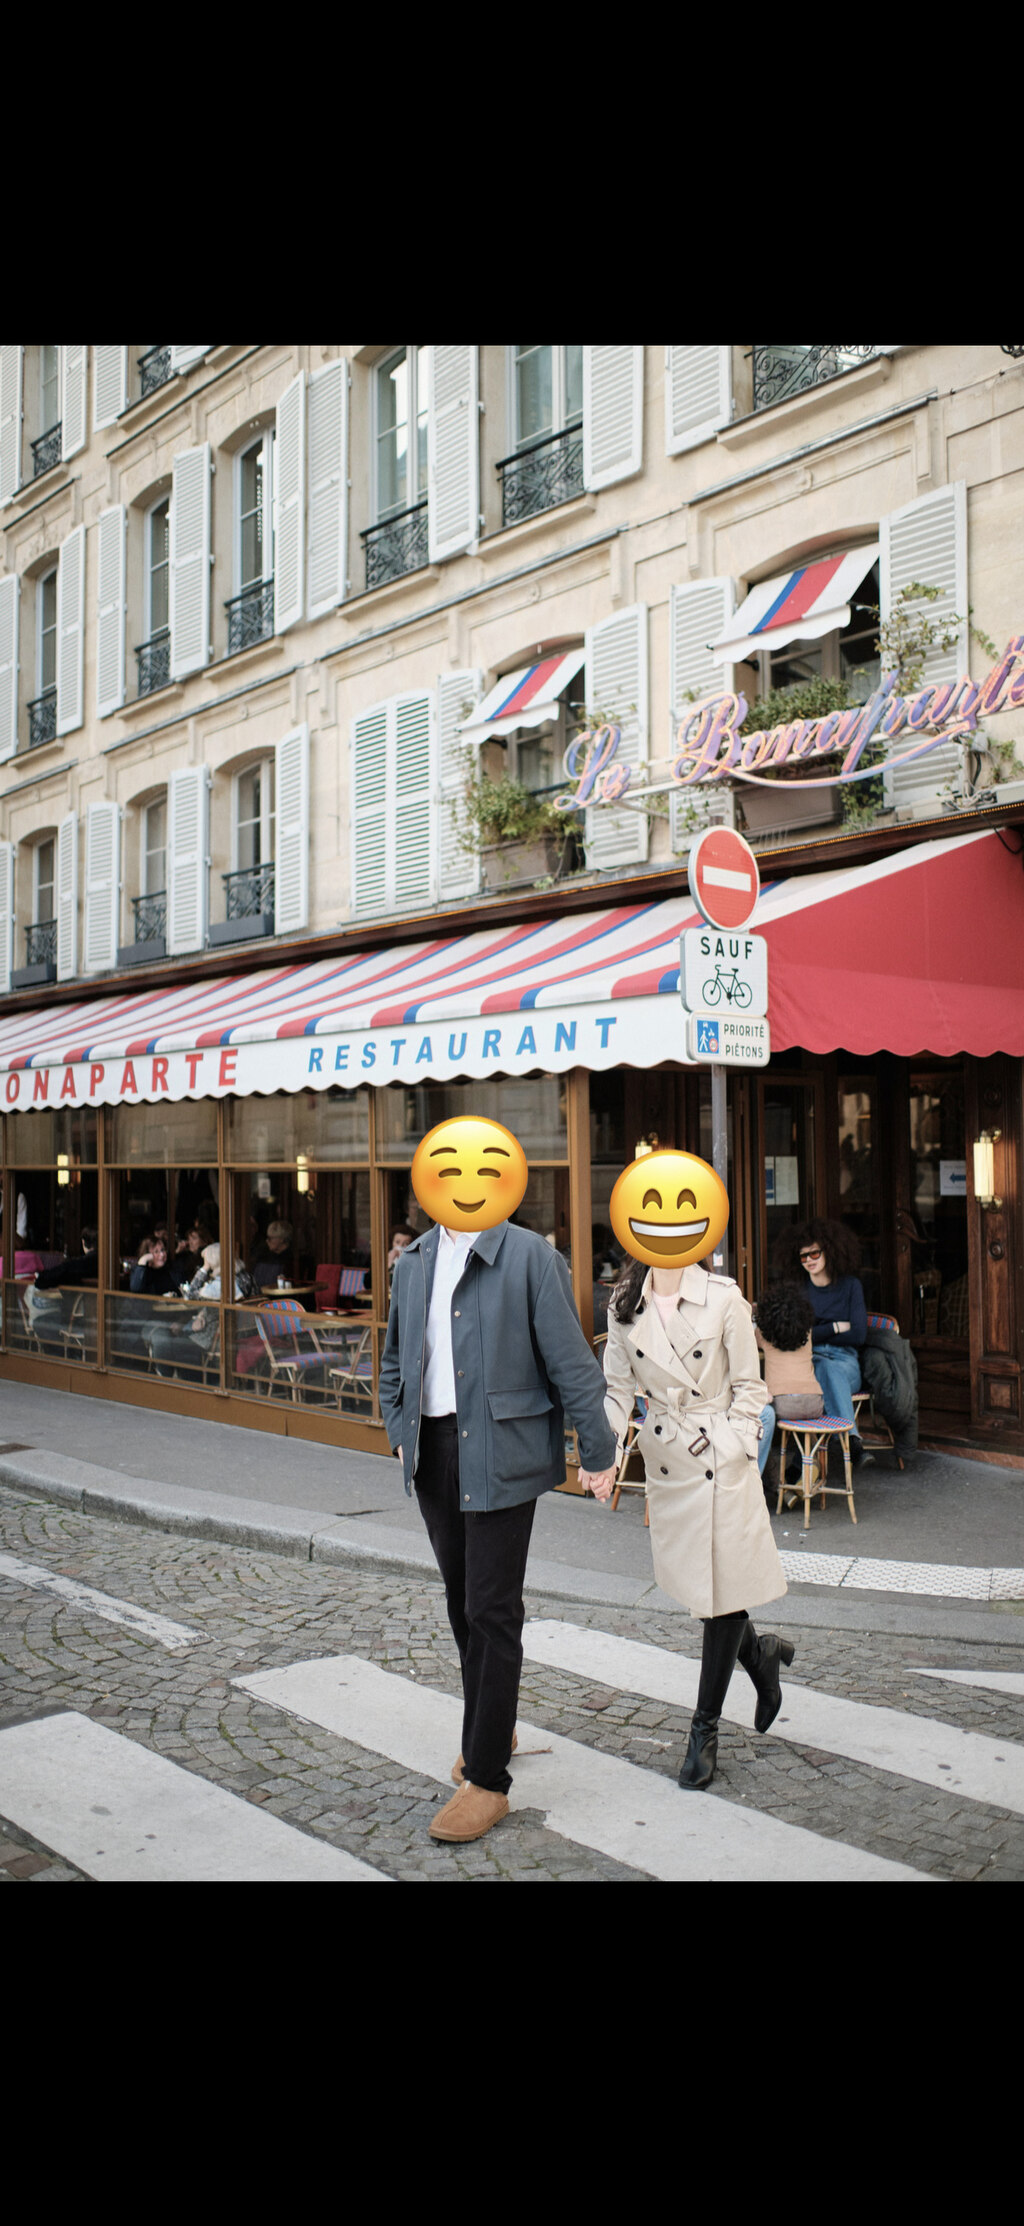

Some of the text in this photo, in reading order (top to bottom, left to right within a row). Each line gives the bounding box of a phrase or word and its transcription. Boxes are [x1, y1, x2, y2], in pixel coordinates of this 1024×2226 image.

[553, 722, 631, 811] Le
[700, 936, 753, 960] SAUF
[723, 1023, 765, 1038] PRIORITÉ
[6, 1017, 617, 1103] ONAPARTE RESTAURANT
[725, 1042, 763, 1058] PIÉTONS
